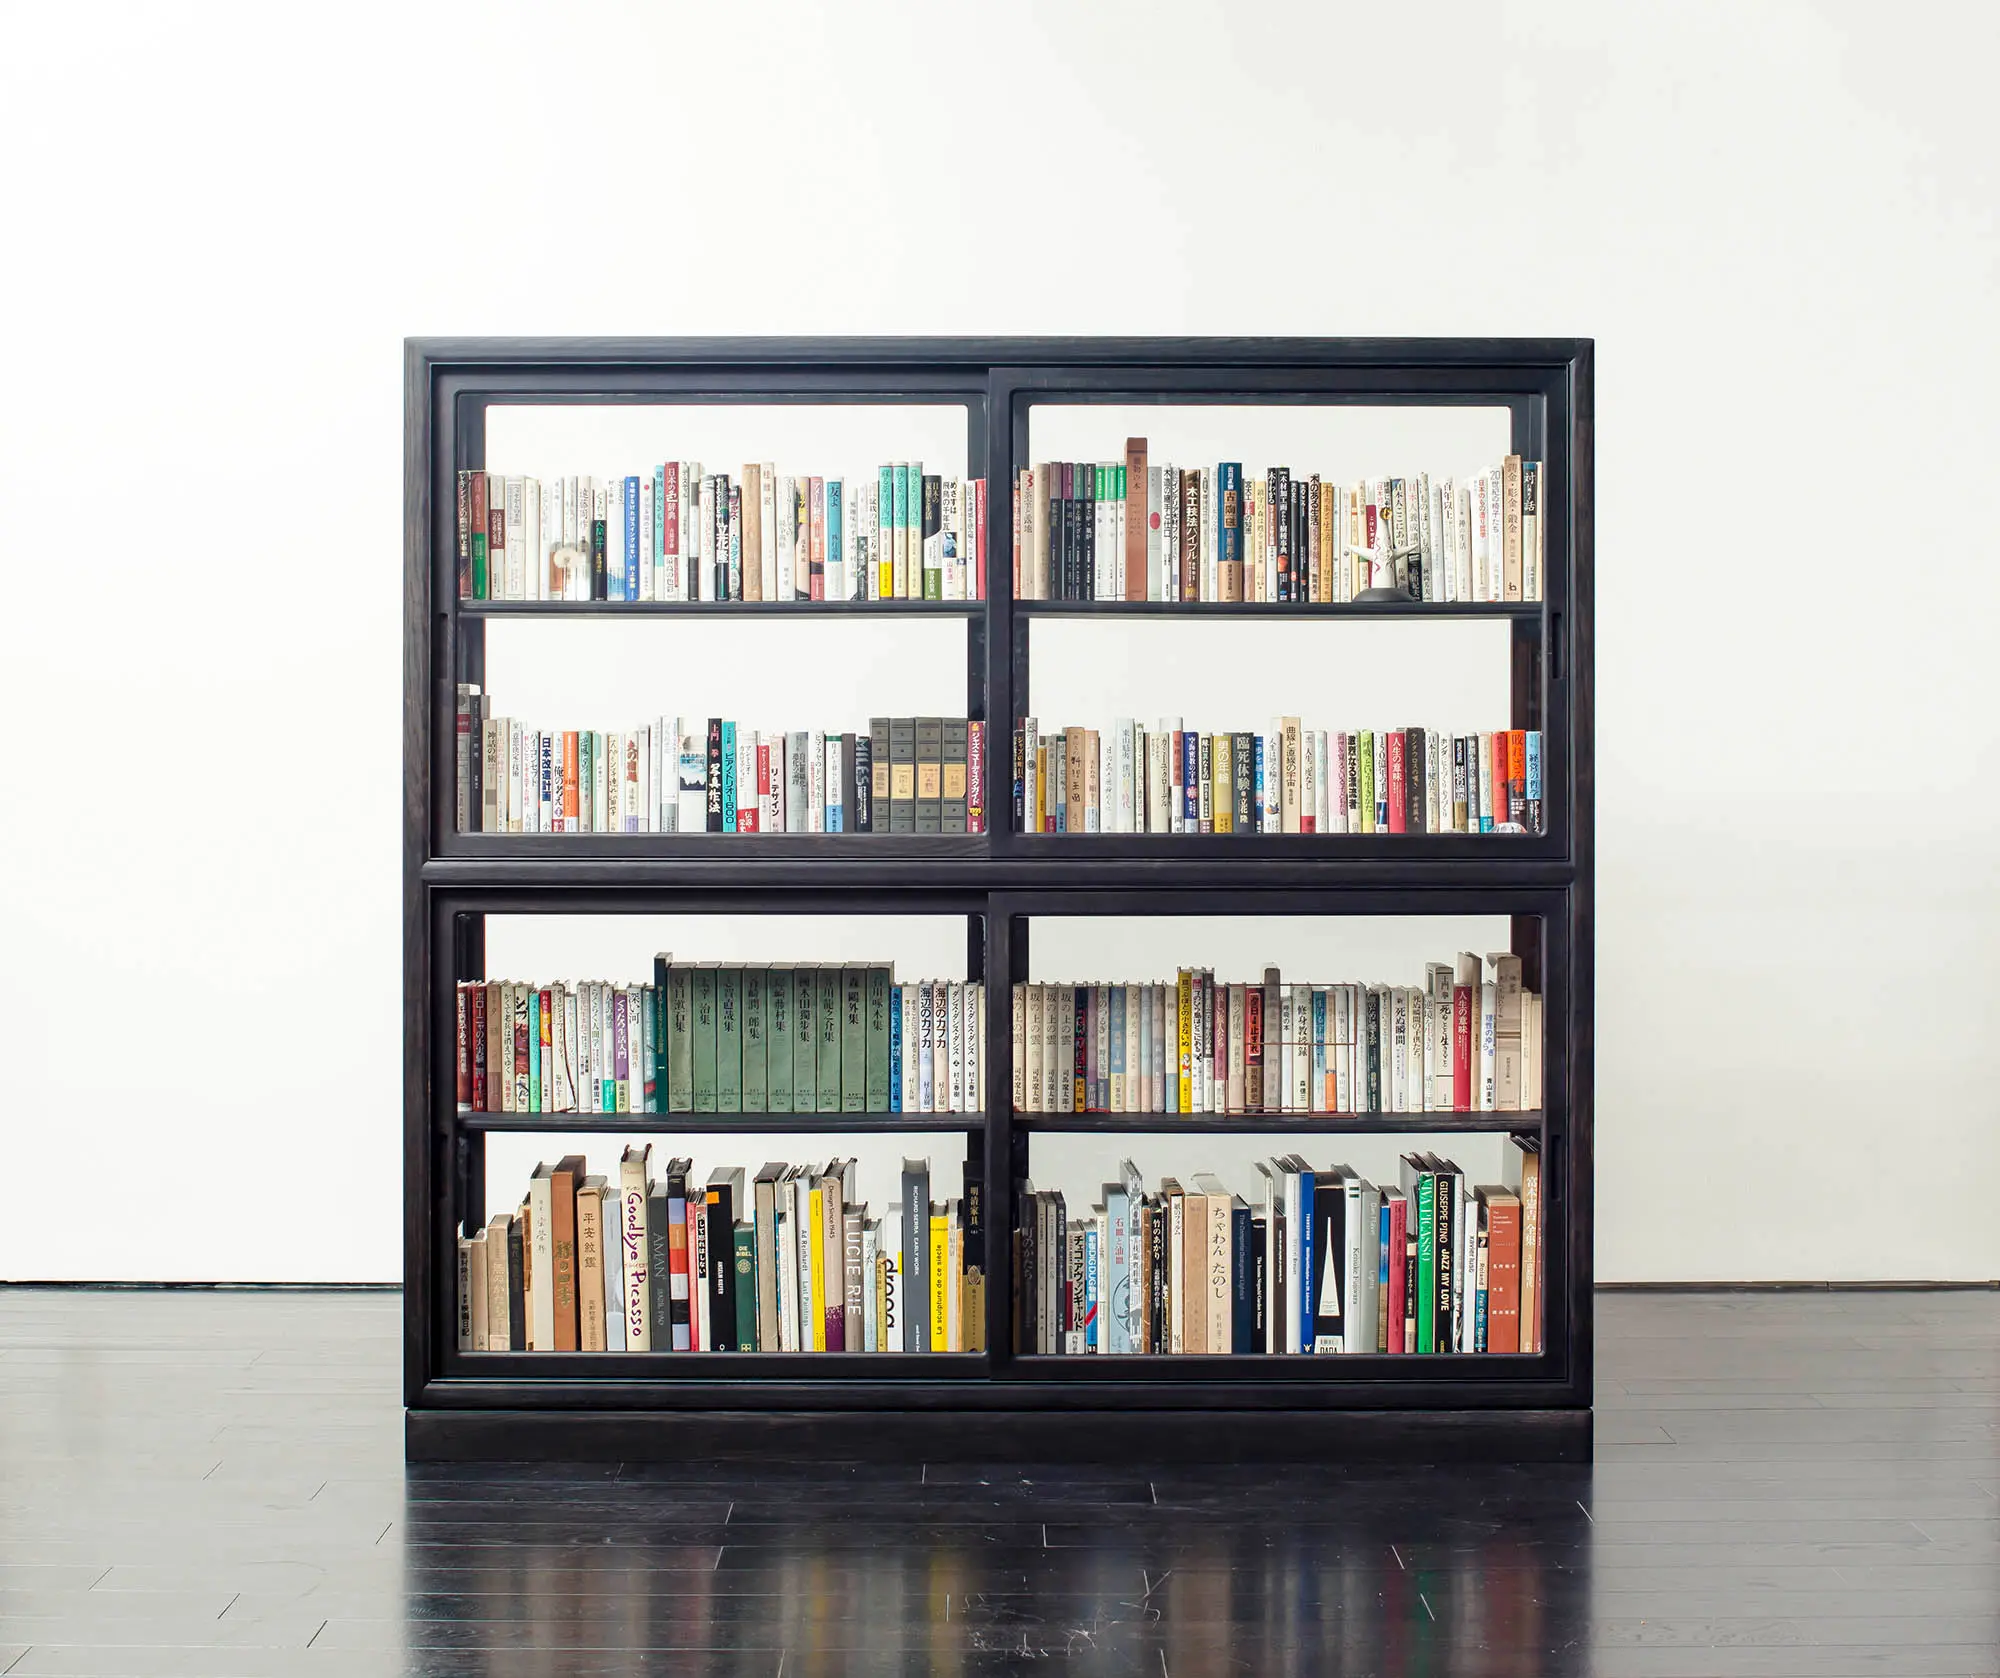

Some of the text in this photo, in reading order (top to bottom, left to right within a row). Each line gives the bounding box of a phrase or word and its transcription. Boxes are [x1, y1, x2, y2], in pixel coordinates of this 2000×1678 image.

[668, 468, 678, 520] 日本の色辞典
[1310, 475, 1319, 525] 木のある生活
[1186, 487, 1198, 560] 木工技法バイブル
[542, 737, 552, 801] 日本改造計画
[1236, 736, 1250, 790] 臨死体験
[1286, 726, 1296, 787] 曲線と直線の宇宙
[1392, 736, 1401, 781] 人生の意味
[554, 766, 564, 806] 俺の考え
[708, 763, 721, 813] 写真作法
[629, 992, 641, 1024] 深い河
[920, 987, 931, 1049] 海辺のカフカ
[935, 987, 946, 1049] 海辺のカフカ
[952, 989, 960, 1056] ダンス・ダンス・ダンス
[967, 989, 975, 1056] ダンス・ダンス・ダンス
[1013, 992, 1023, 1045] 坂の上の雲
[1029, 992, 1041, 1045] 坂の上の雲
[1046, 992, 1057, 1045] 坂の上の雲
[1060, 992, 1072, 1046] 坂の上の雲
[1395, 1007, 1406, 1046] 死ぬ瞬間
[1457, 991, 1468, 1034] 人生の意味
[827, 1185, 835, 1207] Design
[1420, 1179, 1433, 1261] VIVA PICASSO
[583, 1213, 597, 1268] 平安紋鑑
[623, 1192, 647, 1337] Goodbye Picasso
[1152, 1219, 1162, 1260] 竹のあかり
[1212, 1206, 1226, 1299] ちゃわん たのし
[1439, 1180, 1450, 1311] GIUSEPPE PINO JAZZ MY LOVE
[846, 1219, 862, 1315] LUCIE RIE
[936, 1267, 942, 1277] ce
[936, 1279, 942, 1288] de
[936, 1326, 942, 1335] La
